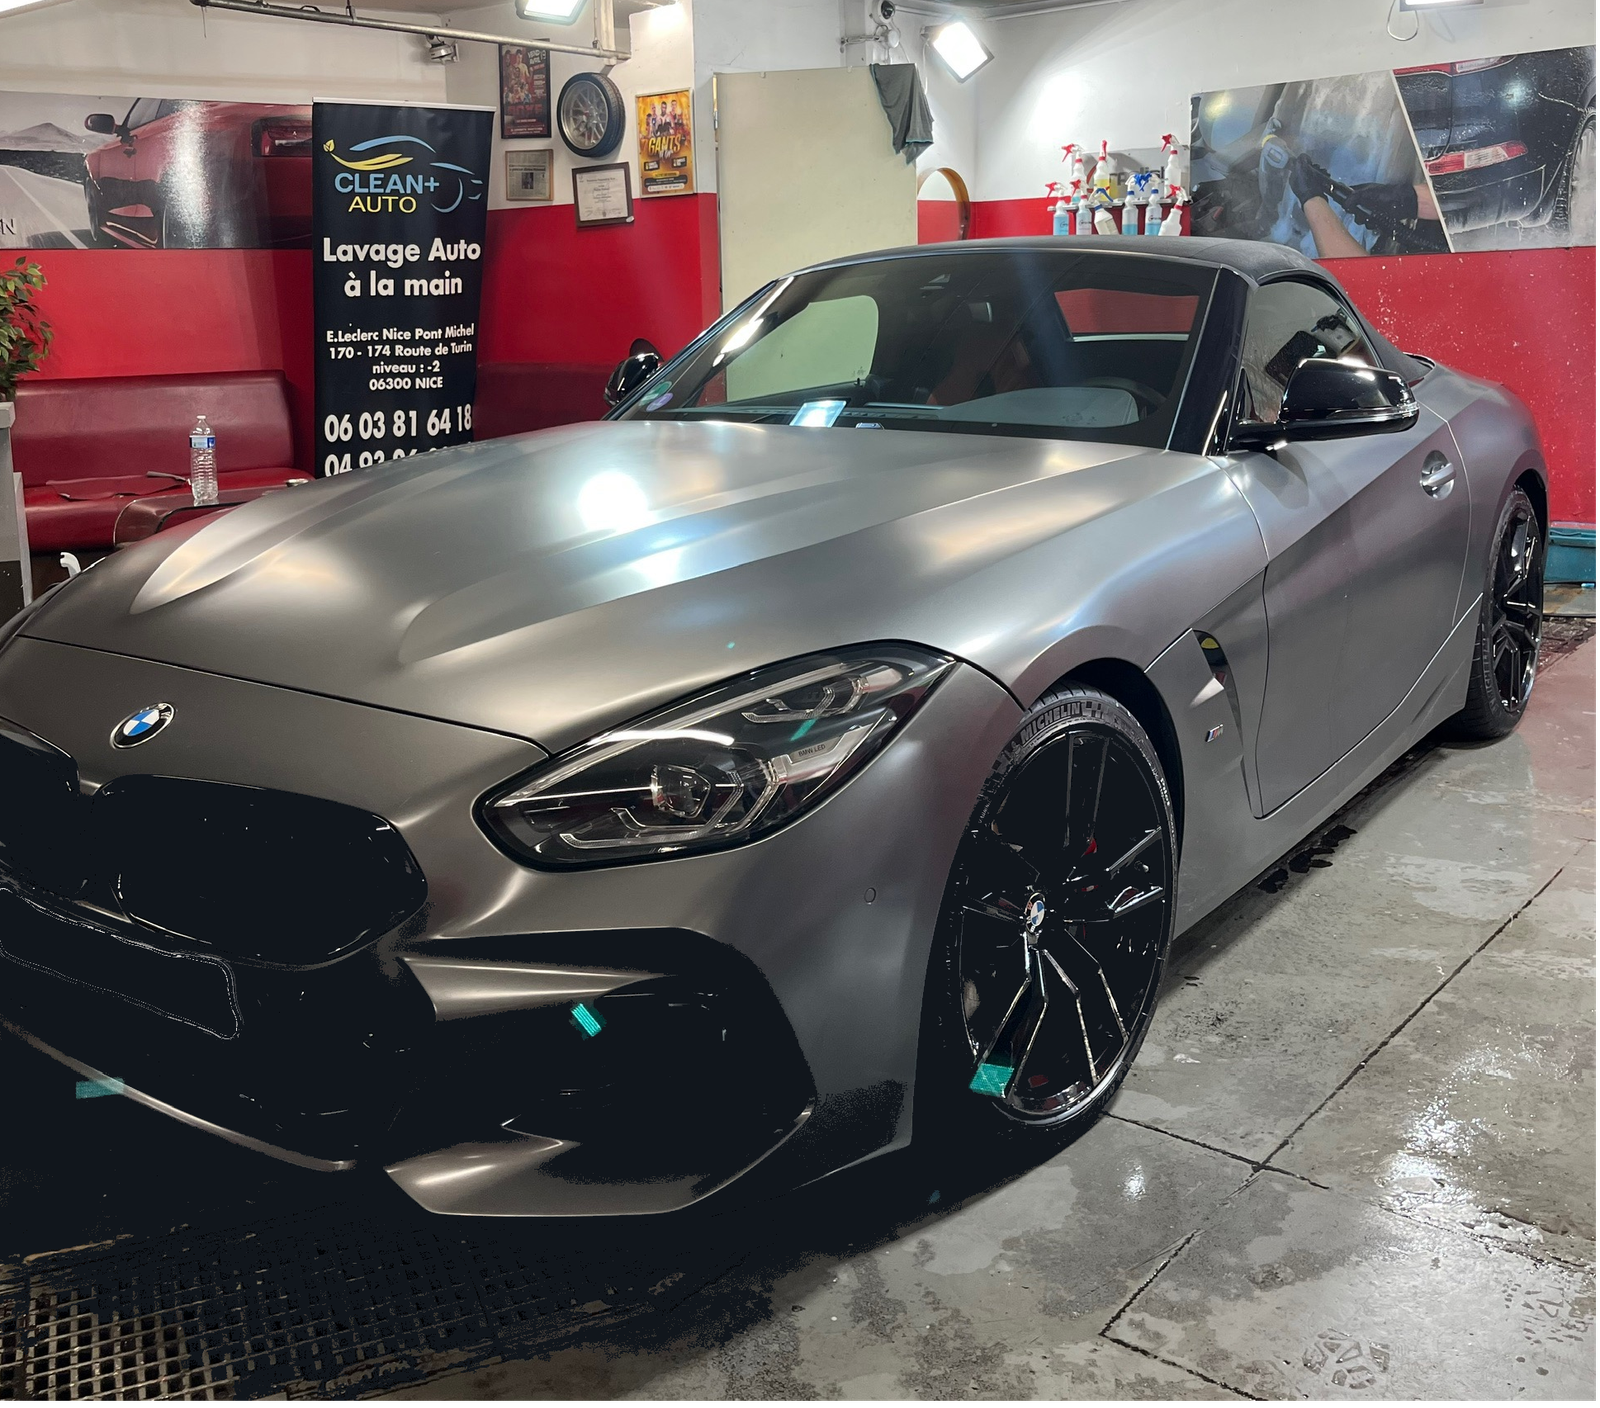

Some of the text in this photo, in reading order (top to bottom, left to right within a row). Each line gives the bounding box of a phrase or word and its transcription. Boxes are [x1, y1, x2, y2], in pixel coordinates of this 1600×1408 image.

[334, 173, 440, 195] CLEAN+
[348, 195, 417, 213] AUTO
[323, 237, 481, 268] Lavage Auto
[344, 270, 463, 297] à la main
[326, 322, 475, 343] E.Leclerc Nice Pont Michel
[329, 347, 355, 360] 170
[367, 345, 391, 358] 174
[395, 344, 432, 357] Route
[434, 343, 449, 356] de
[450, 340, 473, 354] Turin
[372, 361, 417, 375] niveau
[369, 376, 444, 391] 06300 NICE
[324, 403, 472, 443] 06 03 81 64 18
[324, 453, 352, 477] 04
[1020, 701, 1081, 745] MICHELIN
[798, 744, 826, 757] BMW LED
